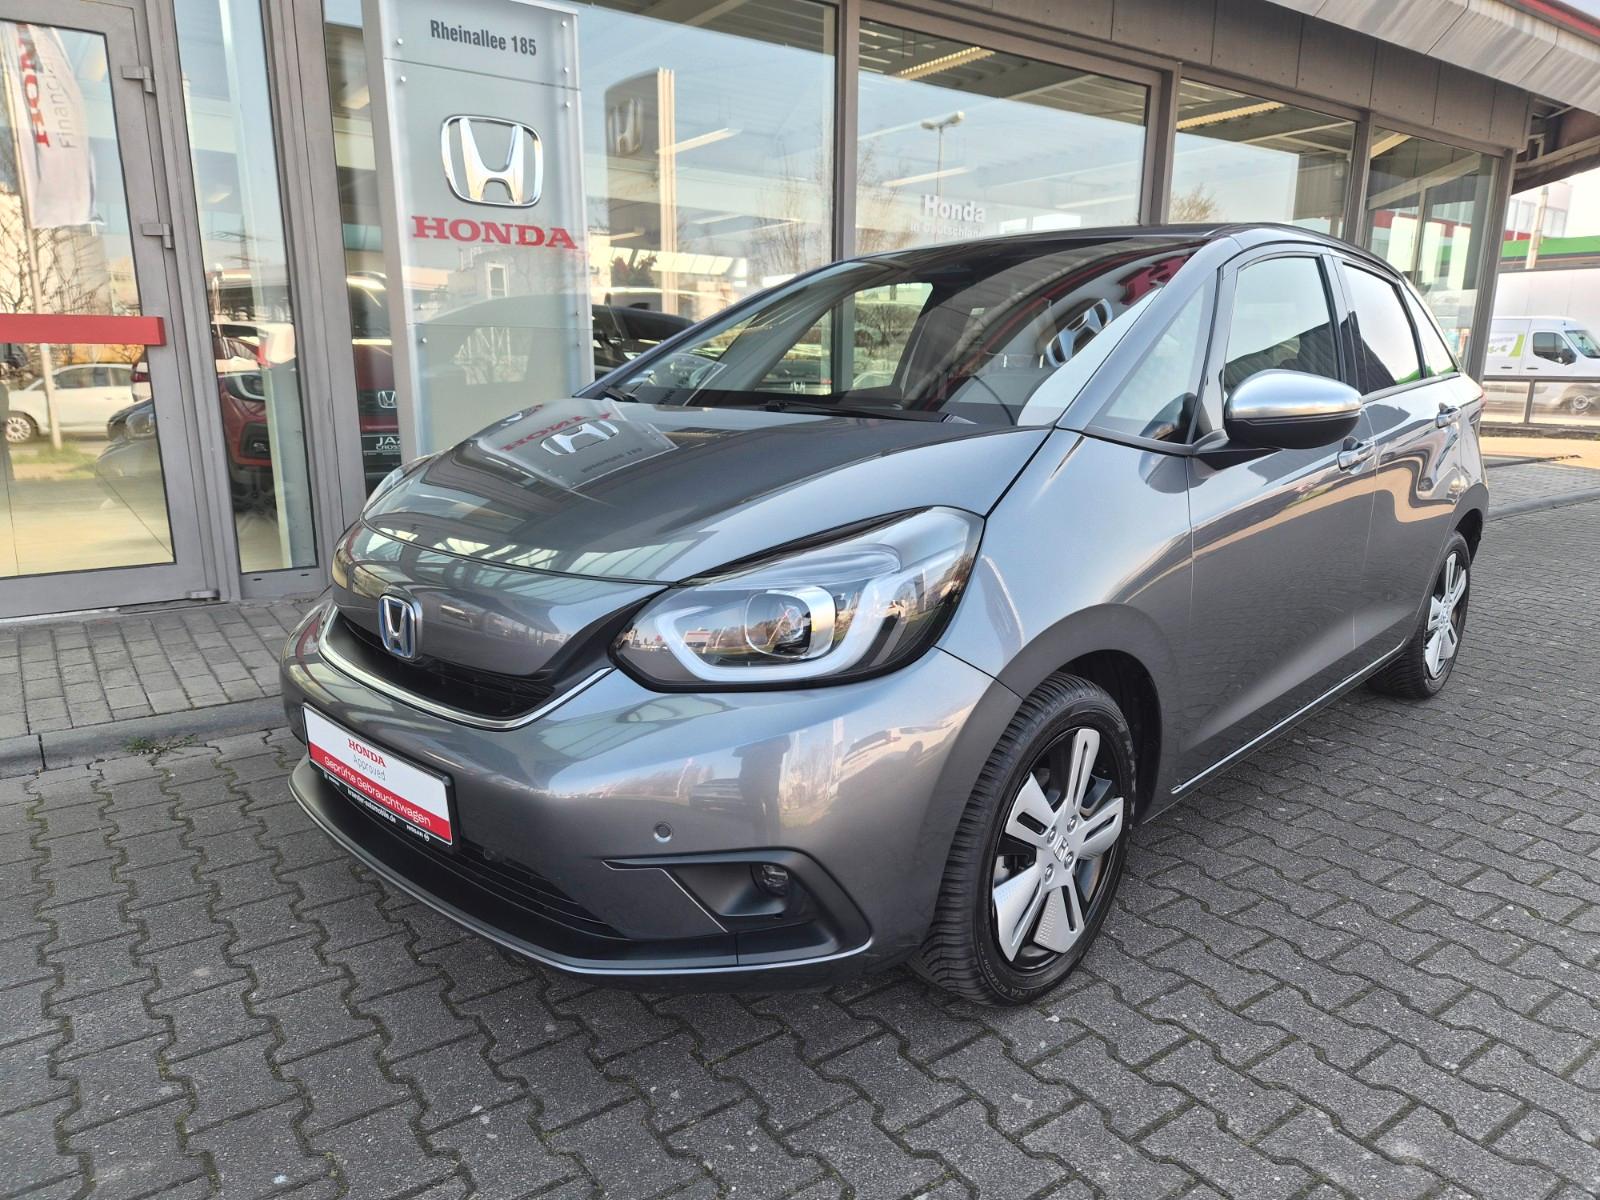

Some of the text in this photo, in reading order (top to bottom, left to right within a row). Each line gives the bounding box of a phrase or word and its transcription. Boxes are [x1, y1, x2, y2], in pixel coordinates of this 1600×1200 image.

[430, 19, 537, 56] Rheinallee 185
[924, 194, 986, 223] Honda
[411, 215, 578, 250] HONDA
[347, 738, 387, 768] HONDA
[353, 754, 386, 782] Approved
[357, 777, 432, 827] Gebrauchtwagen
